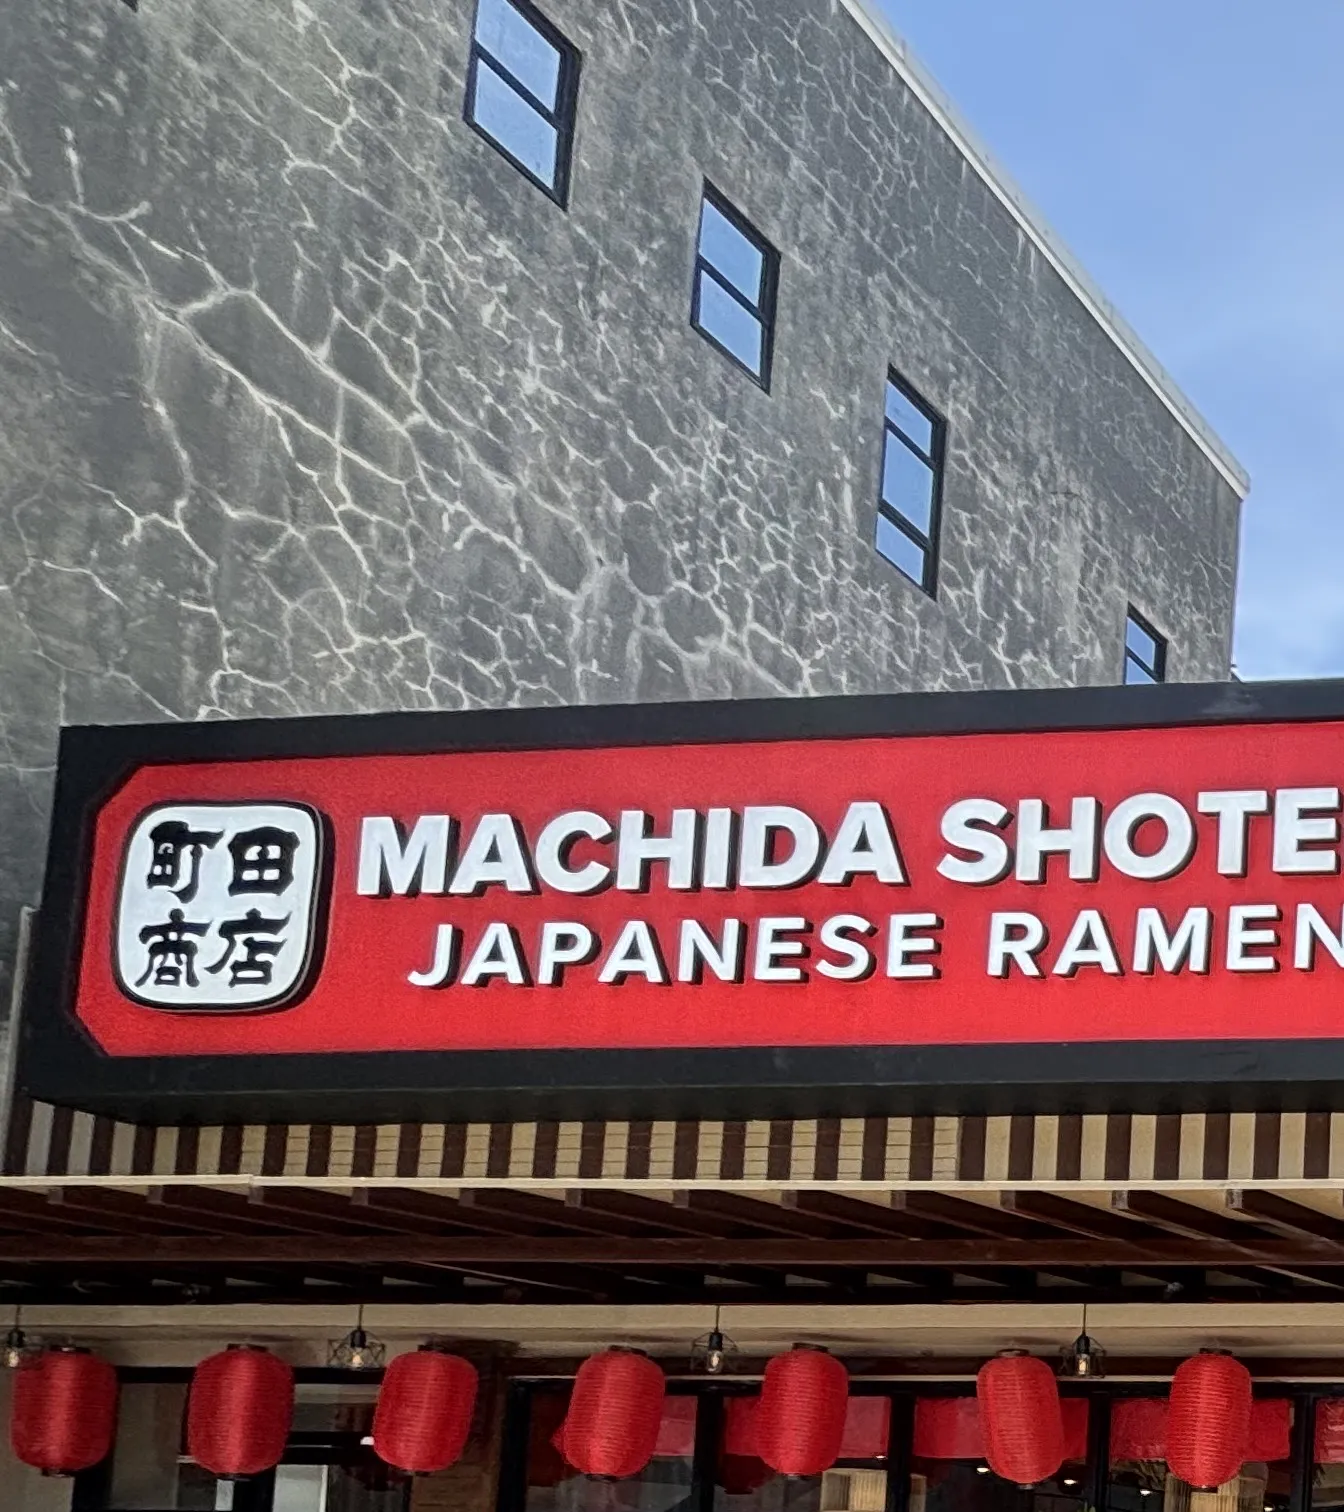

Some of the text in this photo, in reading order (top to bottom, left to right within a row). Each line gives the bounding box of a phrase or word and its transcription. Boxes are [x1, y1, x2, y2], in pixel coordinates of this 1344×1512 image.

[147, 820, 301, 904] 町田
[356, 801, 906, 897] MACHIDA
[134, 907, 293, 988] 商店
[407, 911, 938, 988] JAPANESE
